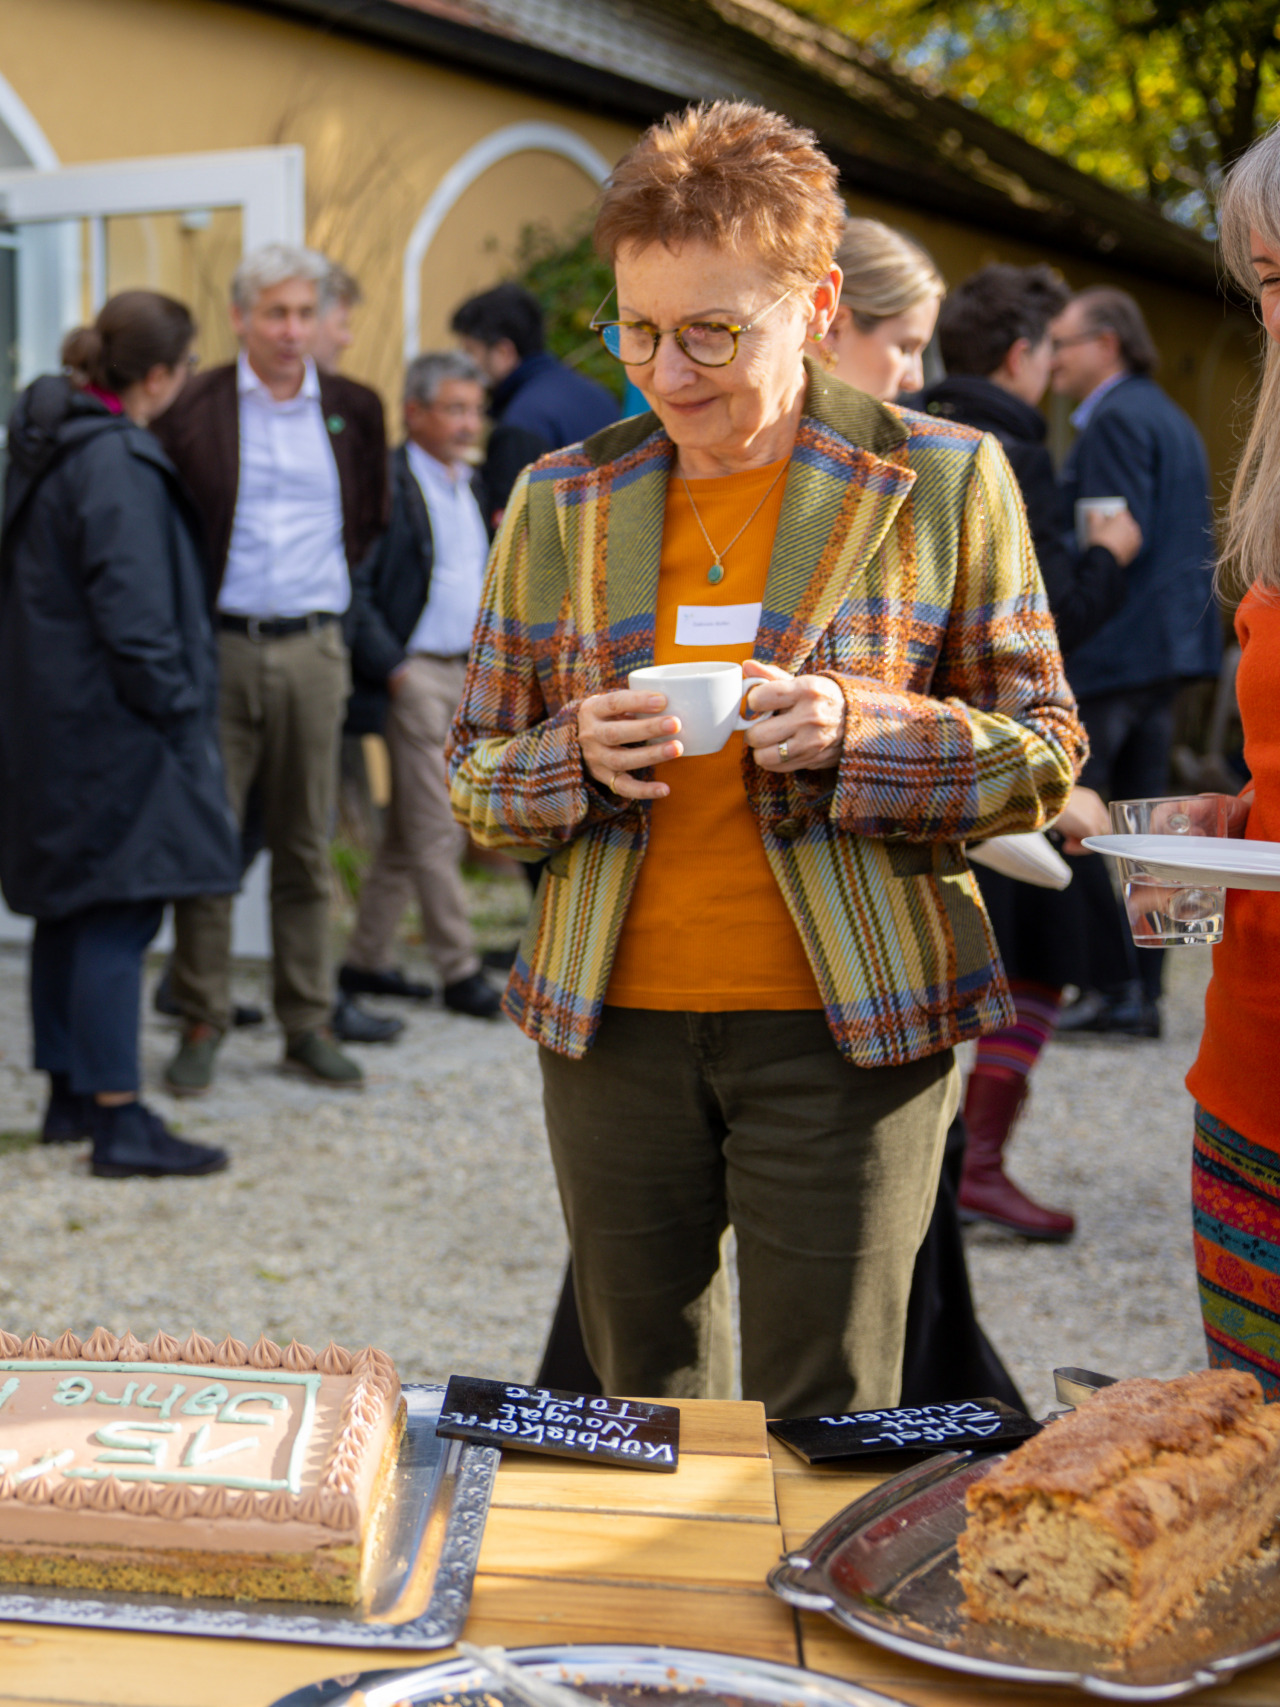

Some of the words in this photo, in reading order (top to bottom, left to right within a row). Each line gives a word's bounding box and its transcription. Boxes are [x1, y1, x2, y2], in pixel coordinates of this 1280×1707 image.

[51, 1375, 289, 1425] Jahre
[497, 1402, 638, 1438] Nougat
[505, 1386, 650, 1422] Torte
[95, 1420, 270, 1468] 15
[439, 1411, 675, 1462] Kürbiskern-
[861, 1421, 1002, 1447] Apfel-
